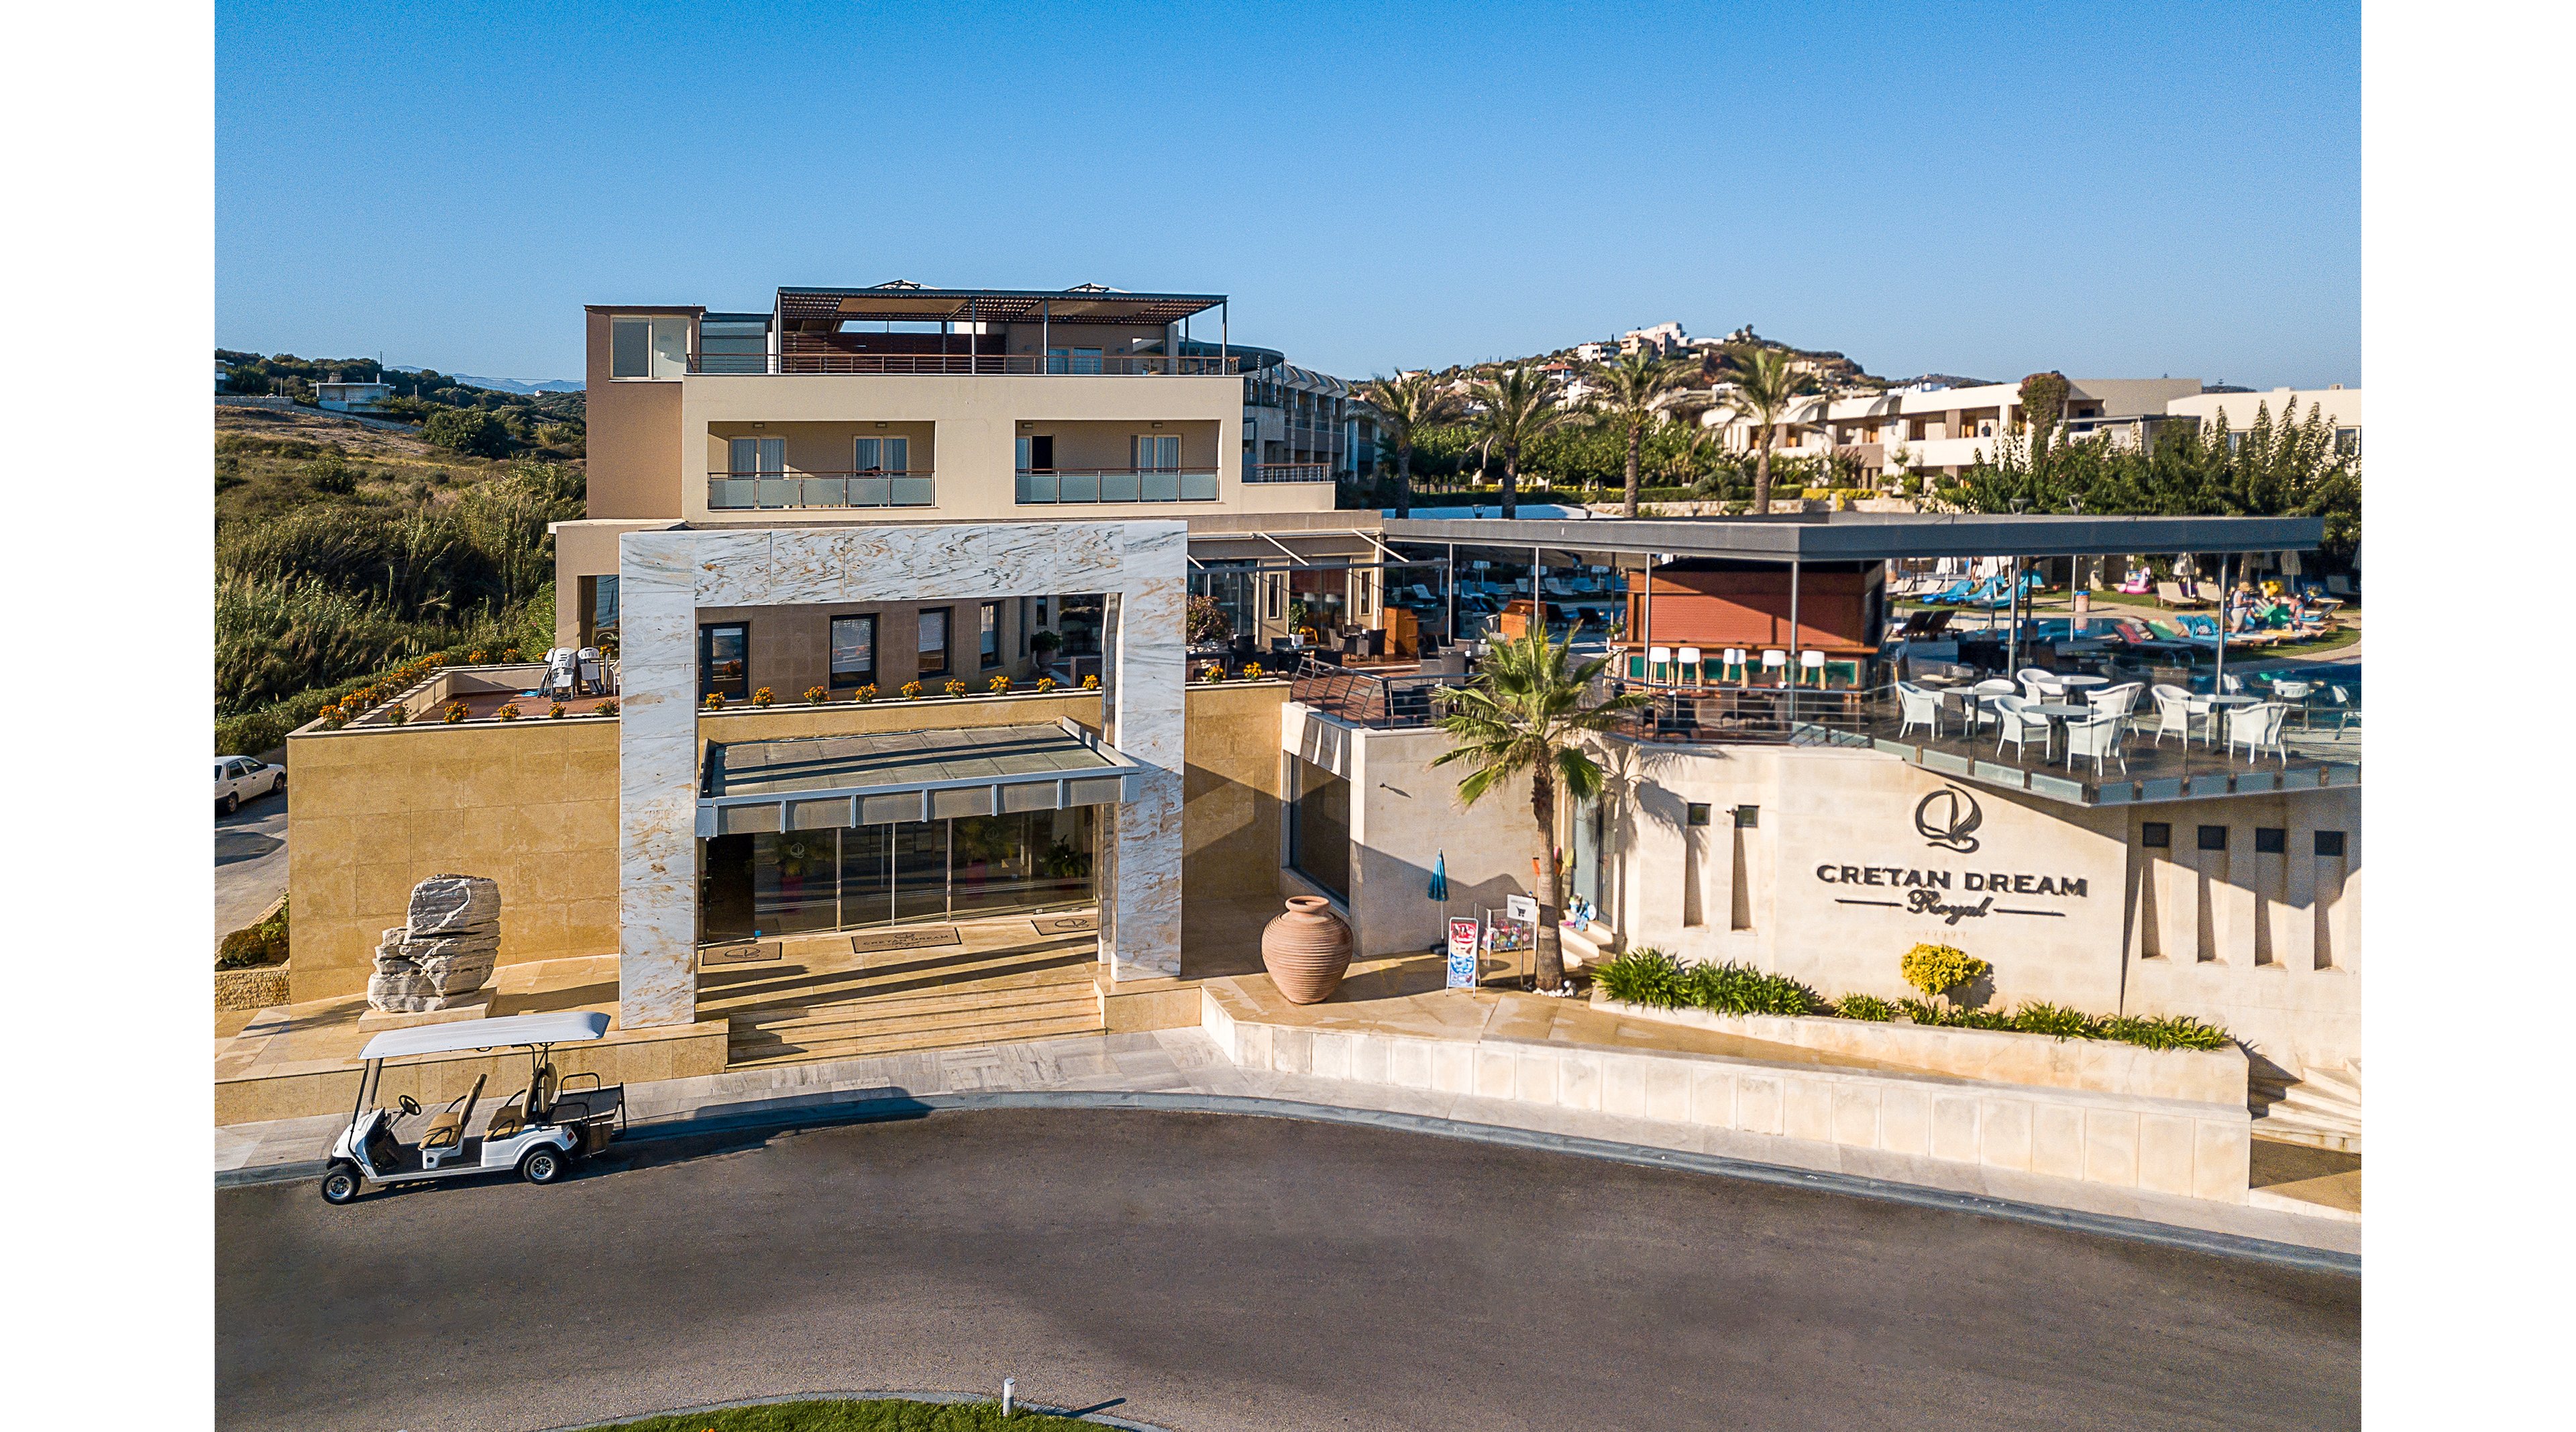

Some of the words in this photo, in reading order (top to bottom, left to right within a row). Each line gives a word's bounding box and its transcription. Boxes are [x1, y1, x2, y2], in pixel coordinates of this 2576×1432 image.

[1816, 864, 1951, 890] CRETAN
[1965, 872, 2088, 897] DREAM
[1907, 889, 1994, 926] Royal
